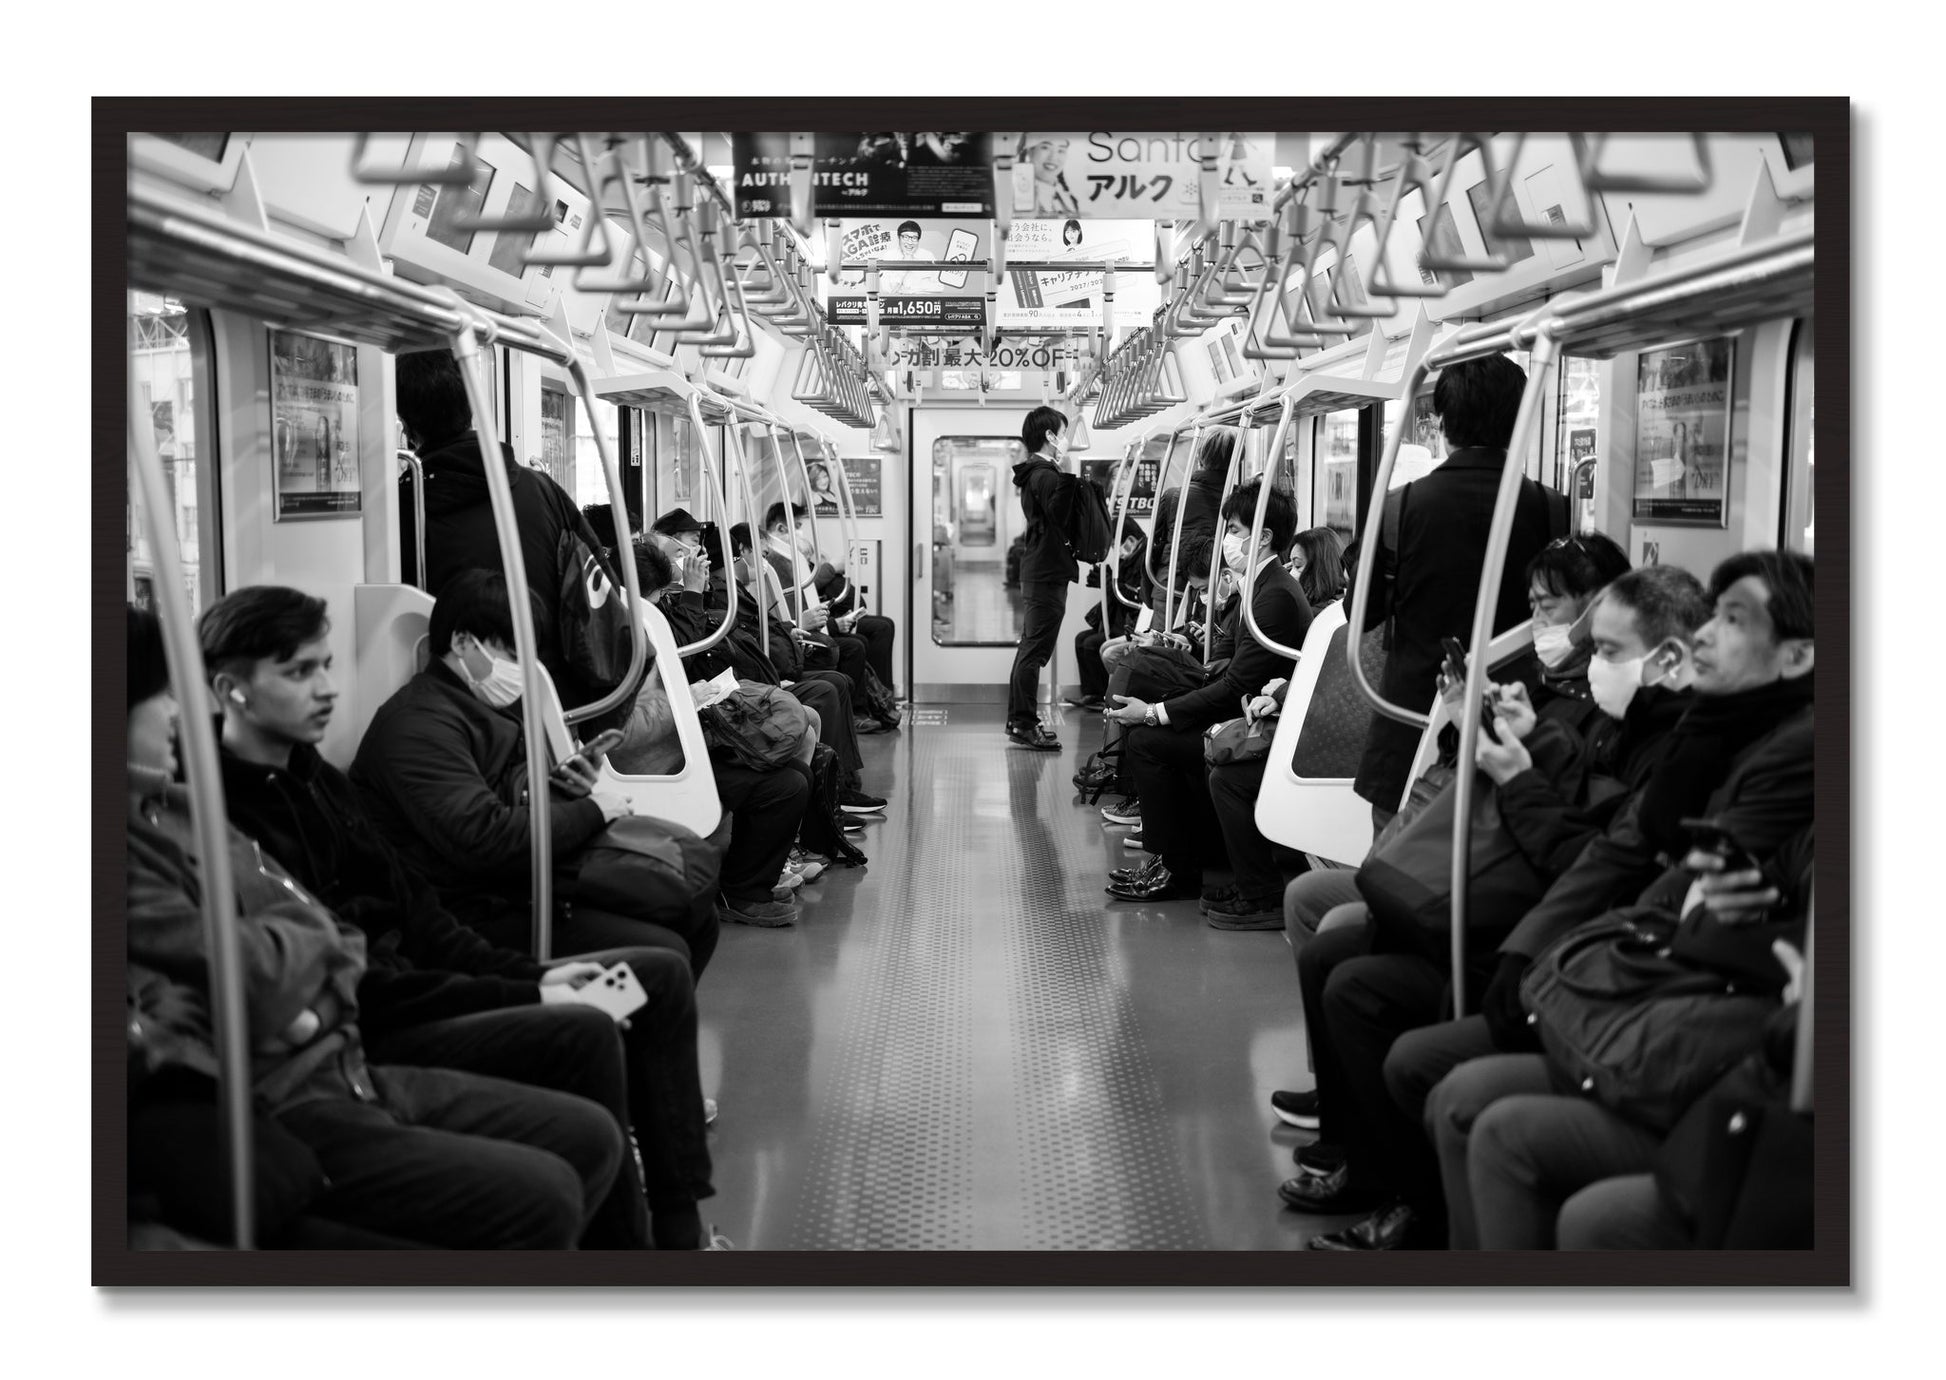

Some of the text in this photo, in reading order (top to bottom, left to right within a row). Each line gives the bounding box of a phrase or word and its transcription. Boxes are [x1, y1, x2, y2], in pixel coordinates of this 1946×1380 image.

[742, 172, 868, 187] AUTHTECH
[1087, 175, 1173, 202] アルク
[1070, 278, 1104, 291] 2027/202
